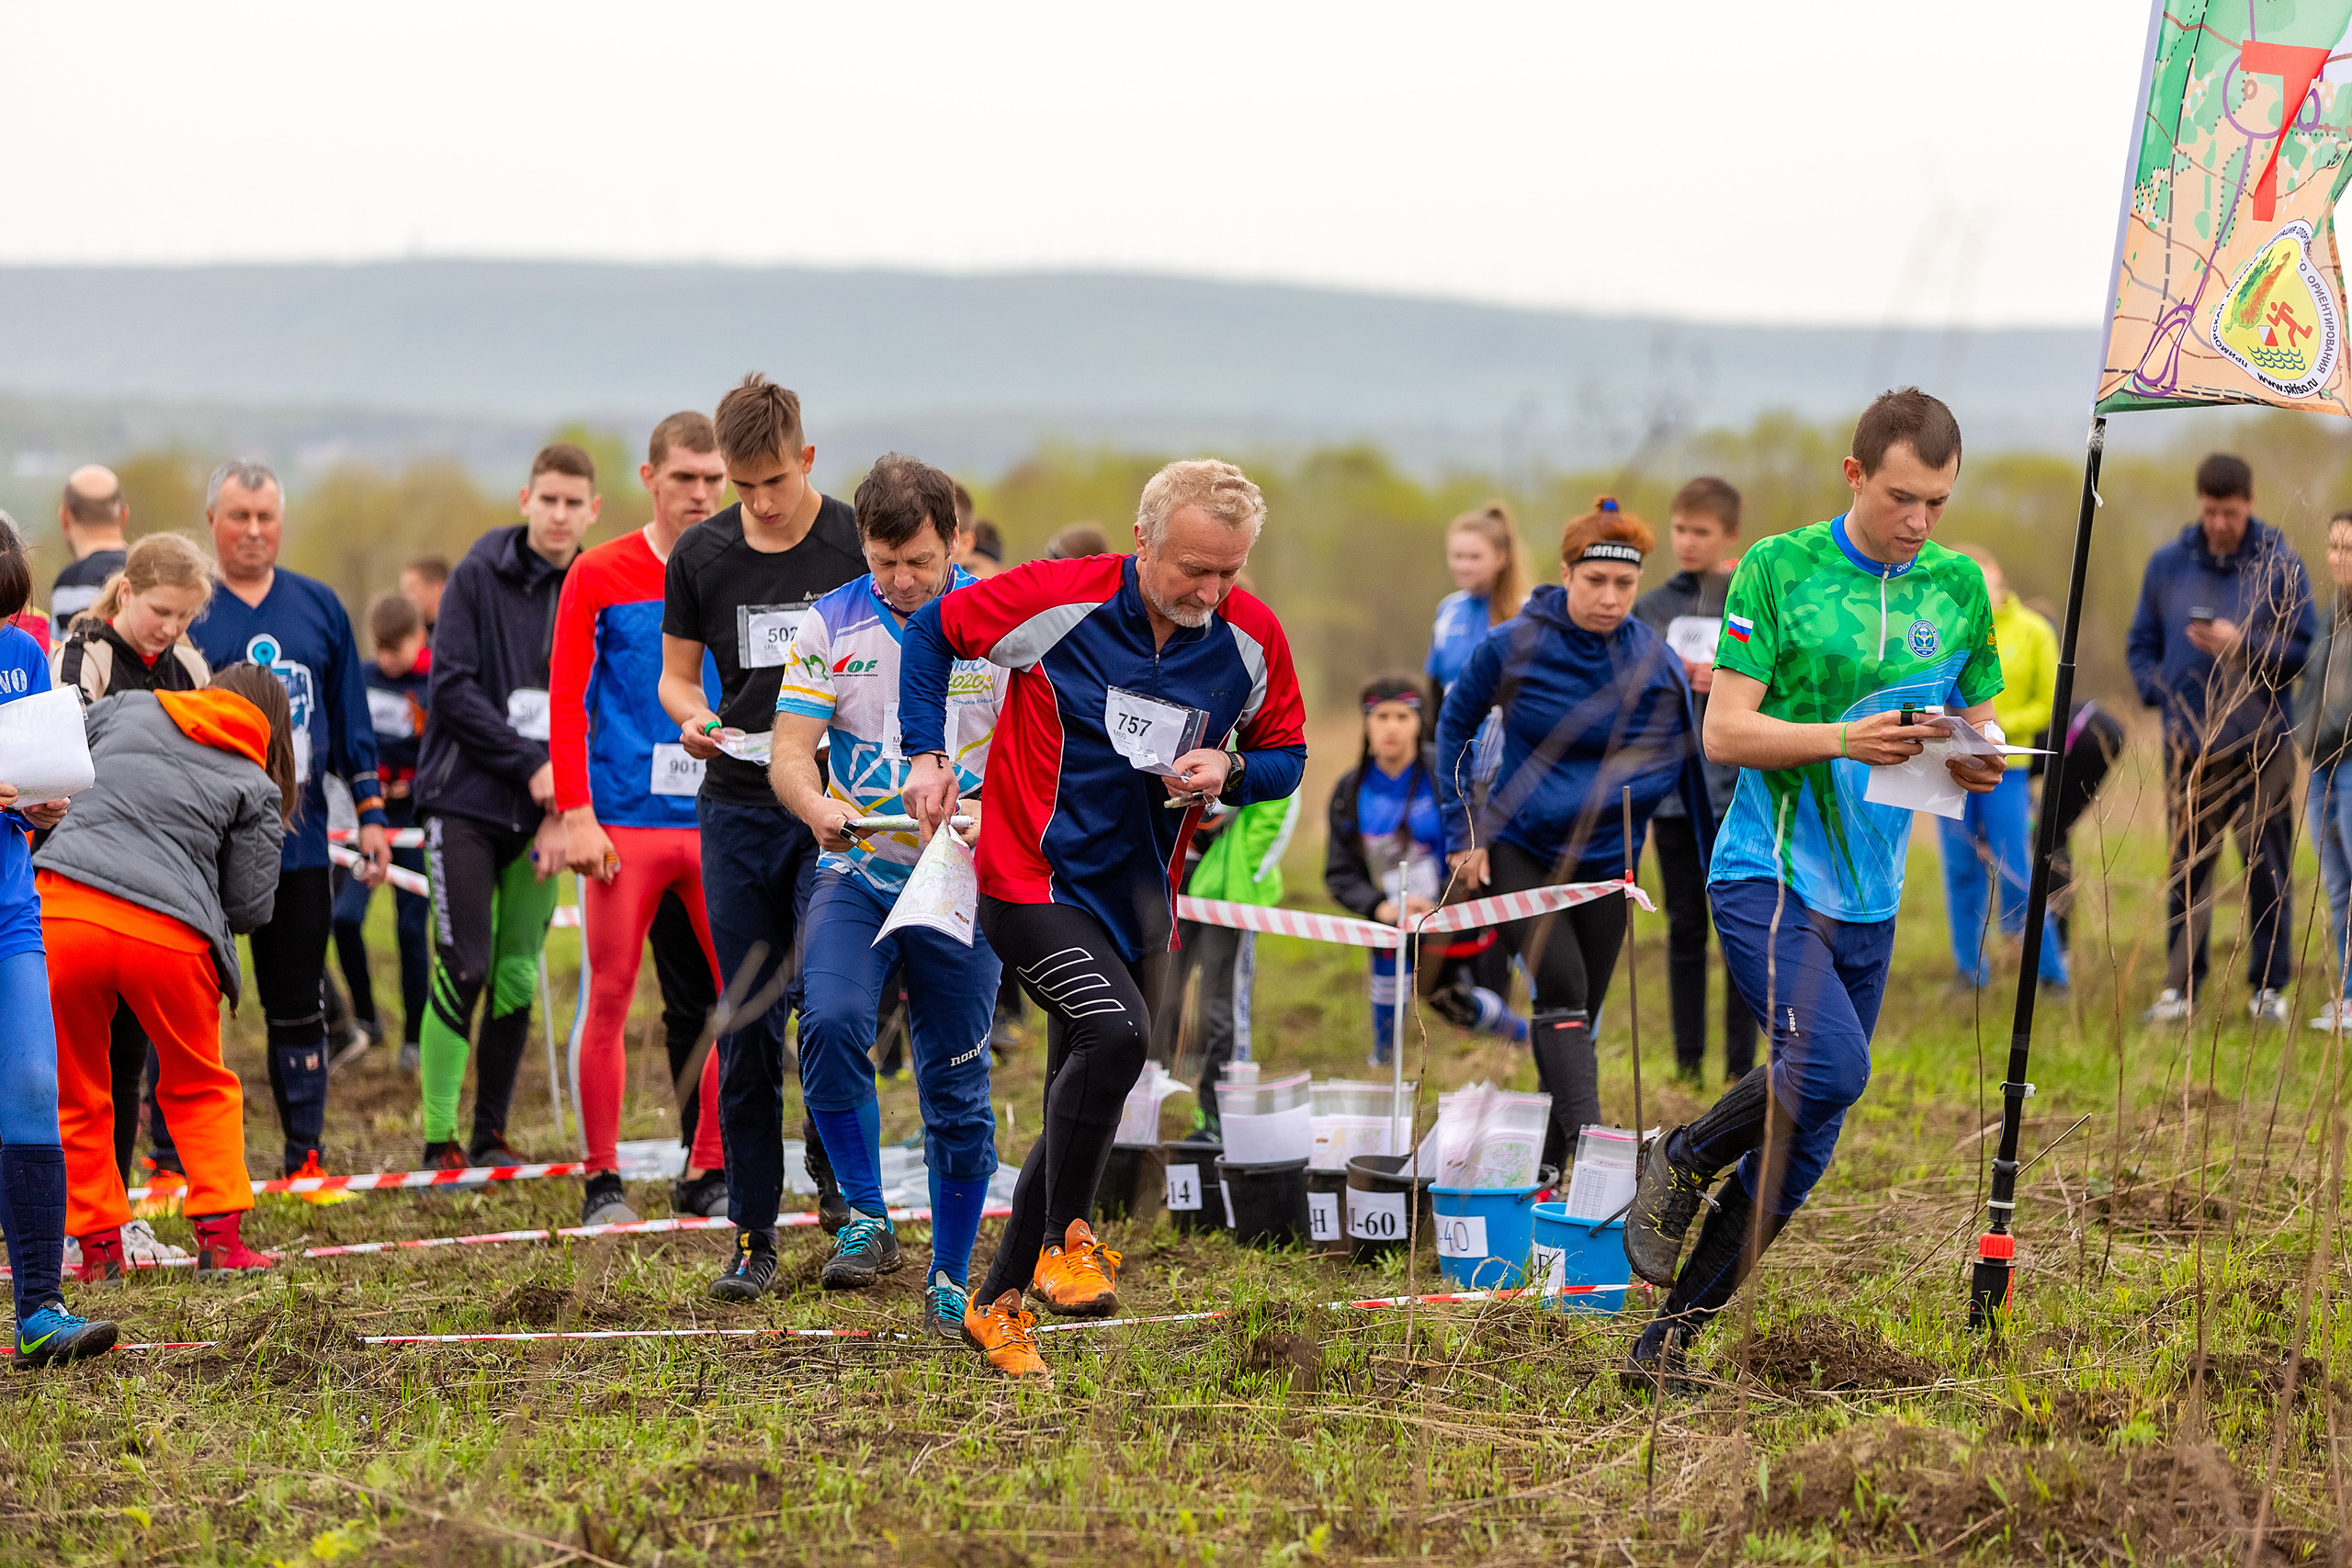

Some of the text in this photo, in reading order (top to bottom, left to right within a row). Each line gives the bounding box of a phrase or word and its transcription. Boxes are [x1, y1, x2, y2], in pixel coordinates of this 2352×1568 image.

[2212, 303, 2248, 368] ПРИМОРСКАЯ
[2307, 275, 2335, 375] ОРИЕНТИРОВАНИЯ
[2256, 371, 2319, 396] www.pkfso.ru
[1583, 544, 1642, 563] noname
[1118, 712, 1152, 737] 757
[670, 758, 697, 775] 901
